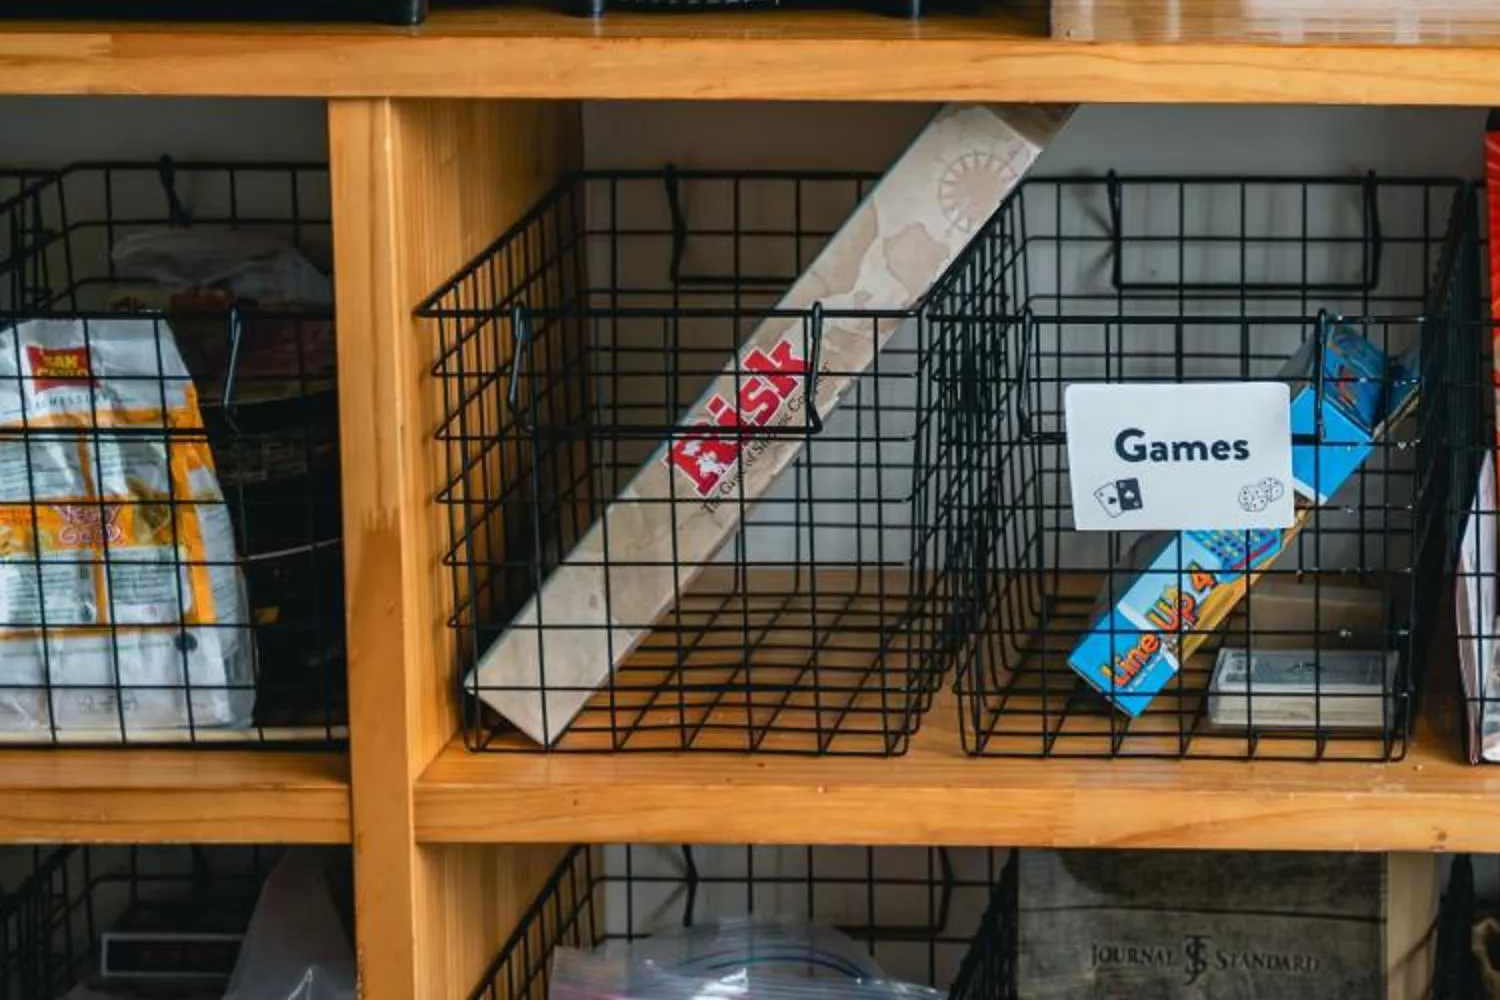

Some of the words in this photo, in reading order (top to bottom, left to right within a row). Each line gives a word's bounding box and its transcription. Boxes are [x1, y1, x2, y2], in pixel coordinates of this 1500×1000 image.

[1114, 428, 1250, 463] Games
[1187, 560, 1219, 593] 4
[1091, 942, 1179, 968] JOURNAL
[1215, 951, 1321, 974] STANDARD
